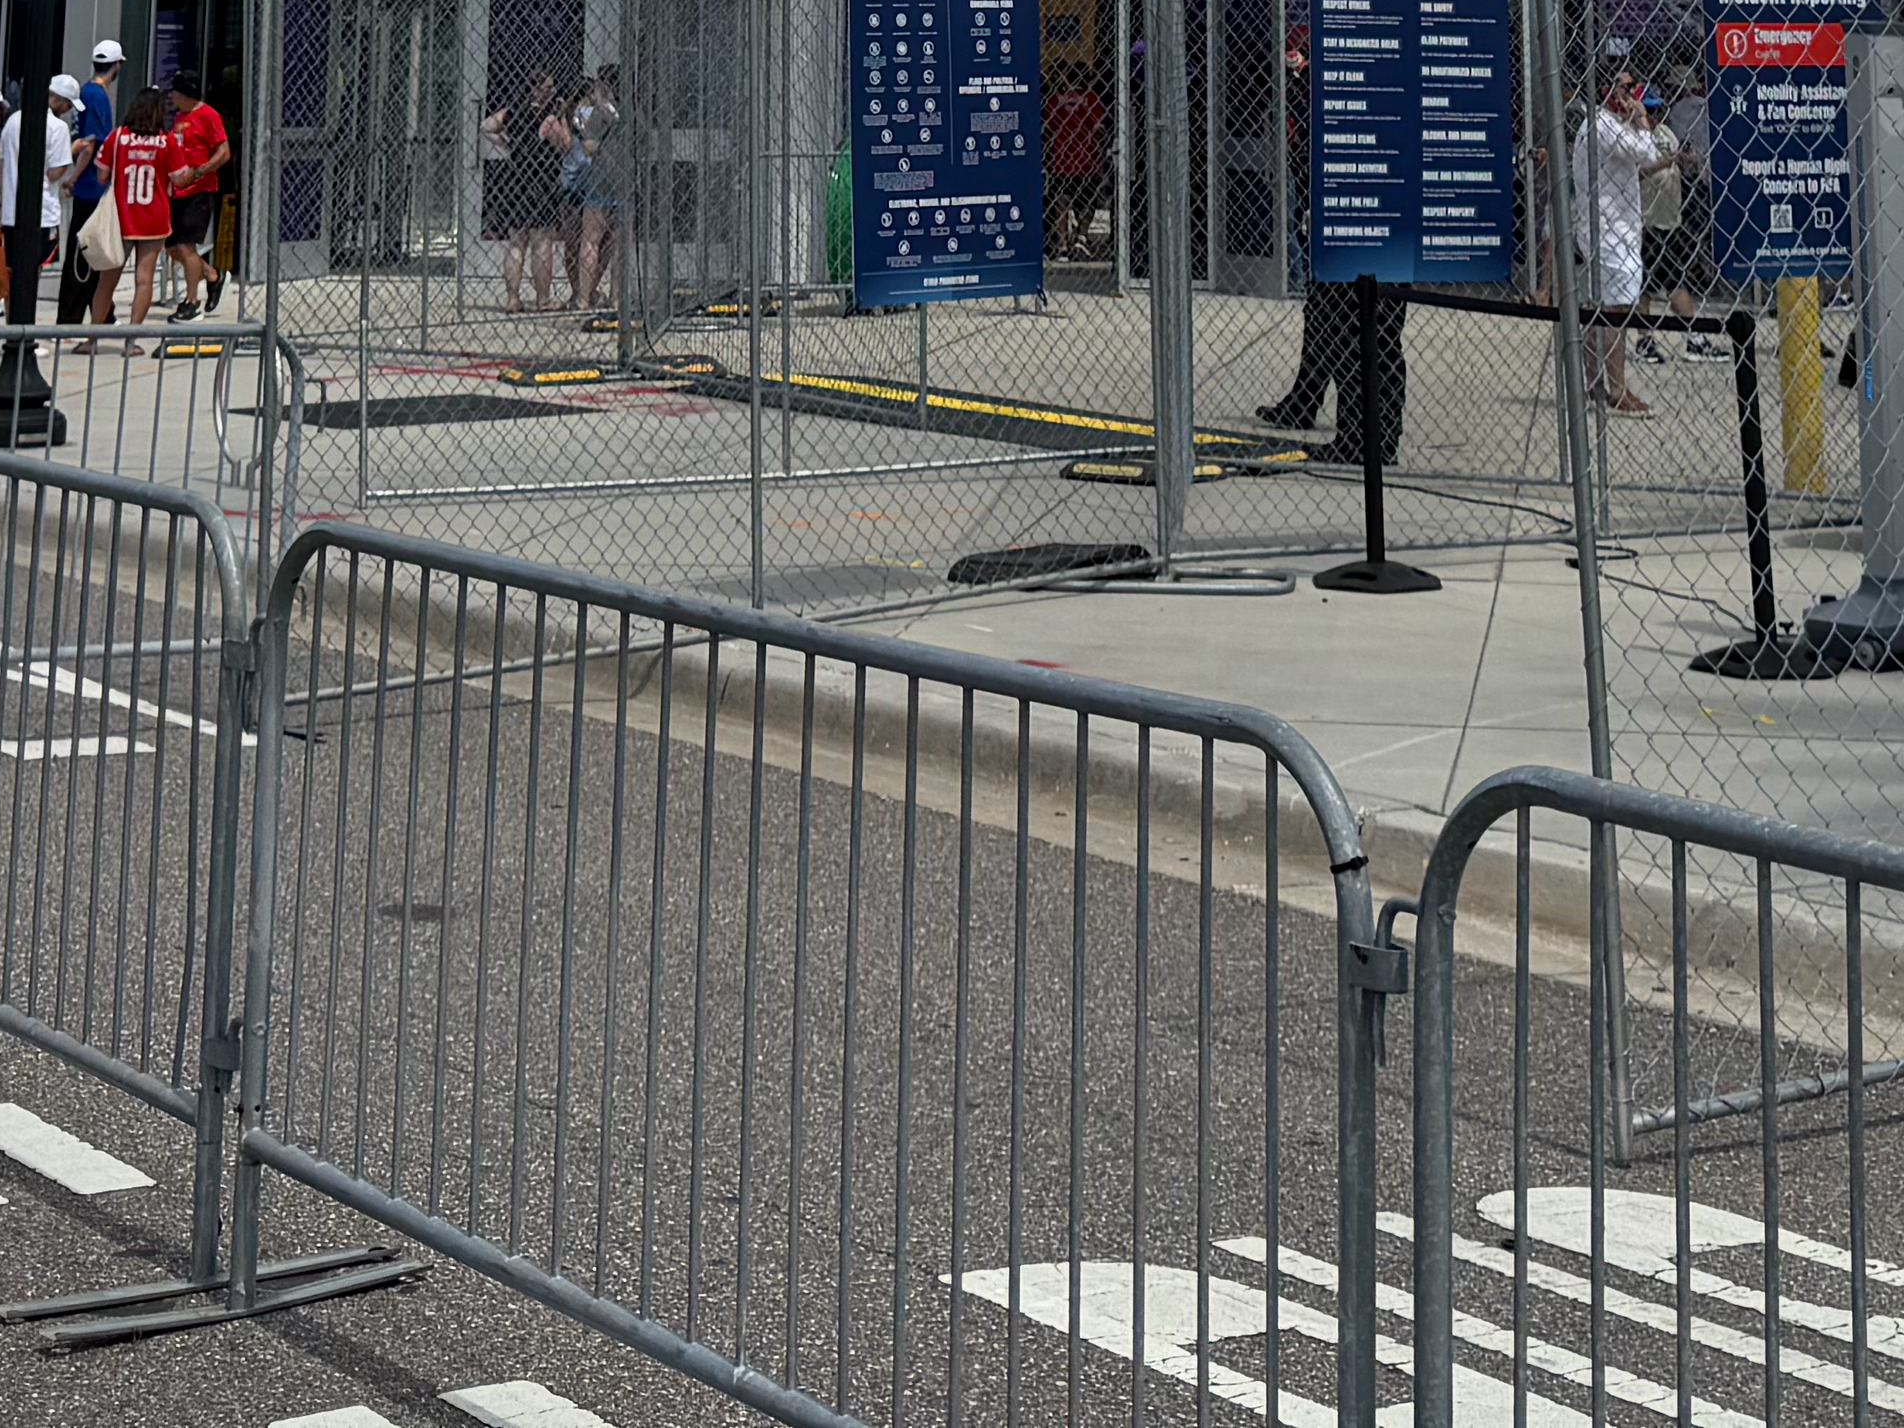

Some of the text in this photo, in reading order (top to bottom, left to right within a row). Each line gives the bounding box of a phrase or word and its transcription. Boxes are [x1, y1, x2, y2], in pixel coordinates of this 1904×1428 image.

[1754, 28, 1812, 46] Emergency
[1757, 84, 1798, 103] Mobility
[1788, 103, 1836, 120] Concerns
[1742, 159, 1777, 176] Report
[124, 164, 156, 206] 10
[1807, 177, 1819, 193] to
